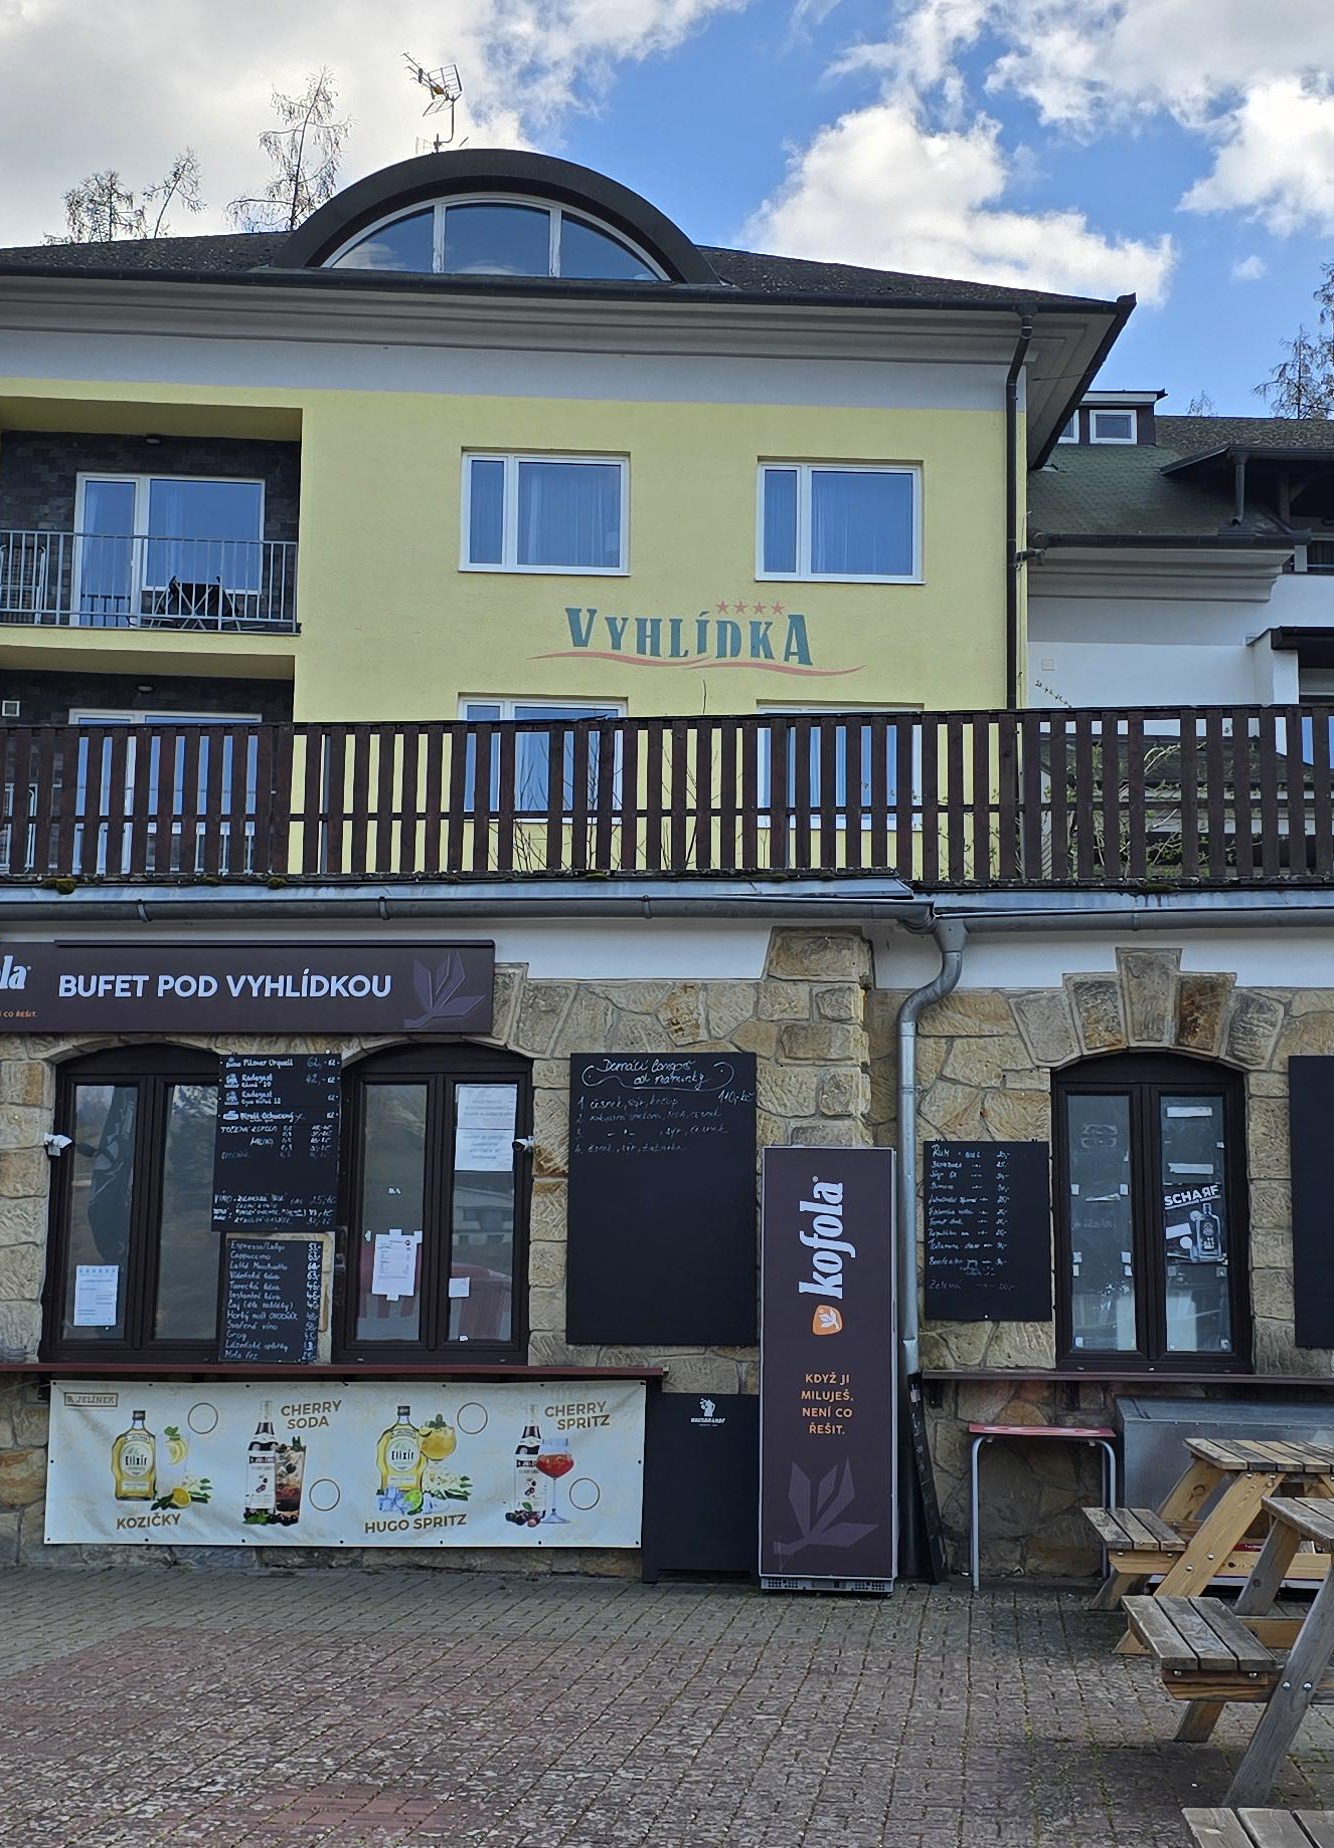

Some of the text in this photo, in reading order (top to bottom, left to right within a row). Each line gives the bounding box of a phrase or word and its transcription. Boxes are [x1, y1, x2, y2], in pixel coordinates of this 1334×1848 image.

[565, 608, 813, 666] VYHLÍDKA
[59, 968, 393, 998] BUFET POD VYHLÍDKOU
[243, 1058, 267, 1067] Pilsner
[268, 1058, 294, 1069] Urquell
[241, 1073, 273, 1083] Radegast
[241, 1090, 273, 1101] Radegast
[799, 1181, 856, 1300] kofola
[805, 1371, 851, 1387] KDYŽ JI
[76, 1394, 115, 1404] JELÍNEK
[280, 1400, 343, 1418] CHERRY
[544, 1401, 608, 1418] CHERRY
[802, 1405, 854, 1419] NENÍ CO
[286, 1415, 331, 1431] SODA
[556, 1413, 612, 1432] SPRITZ
[809, 1421, 846, 1435] ŘEŠIT.
[116, 1512, 182, 1531] KOZIČKY
[364, 1512, 468, 1535] HUGO SPRITZ
